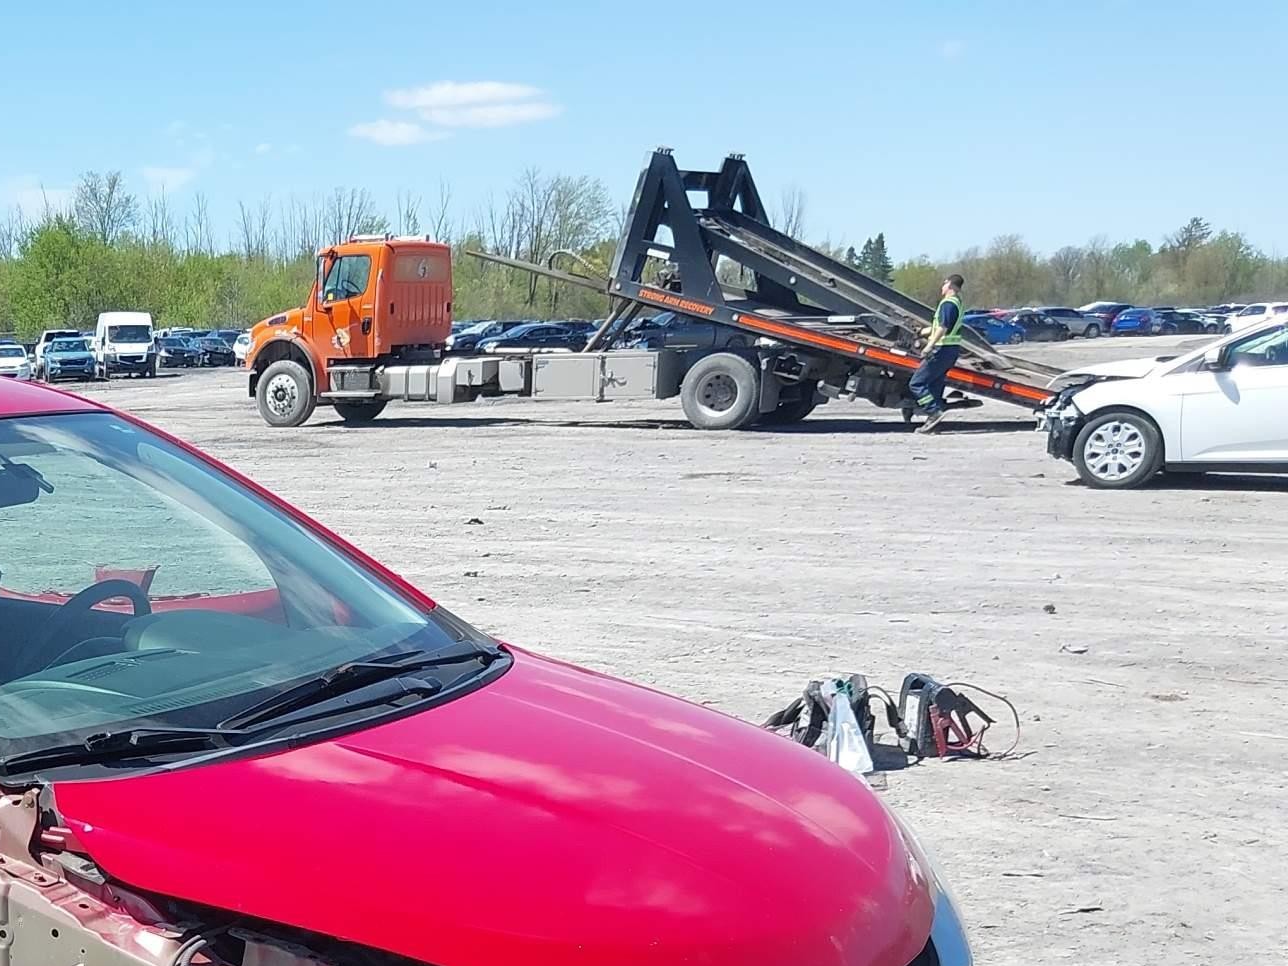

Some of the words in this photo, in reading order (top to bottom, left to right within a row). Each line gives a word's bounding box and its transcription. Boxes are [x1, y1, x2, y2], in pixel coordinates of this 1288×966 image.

[639, 289, 665, 302] STRONG
[664, 296, 680, 306] ARM
[679, 300, 715, 315] RECOVERY
